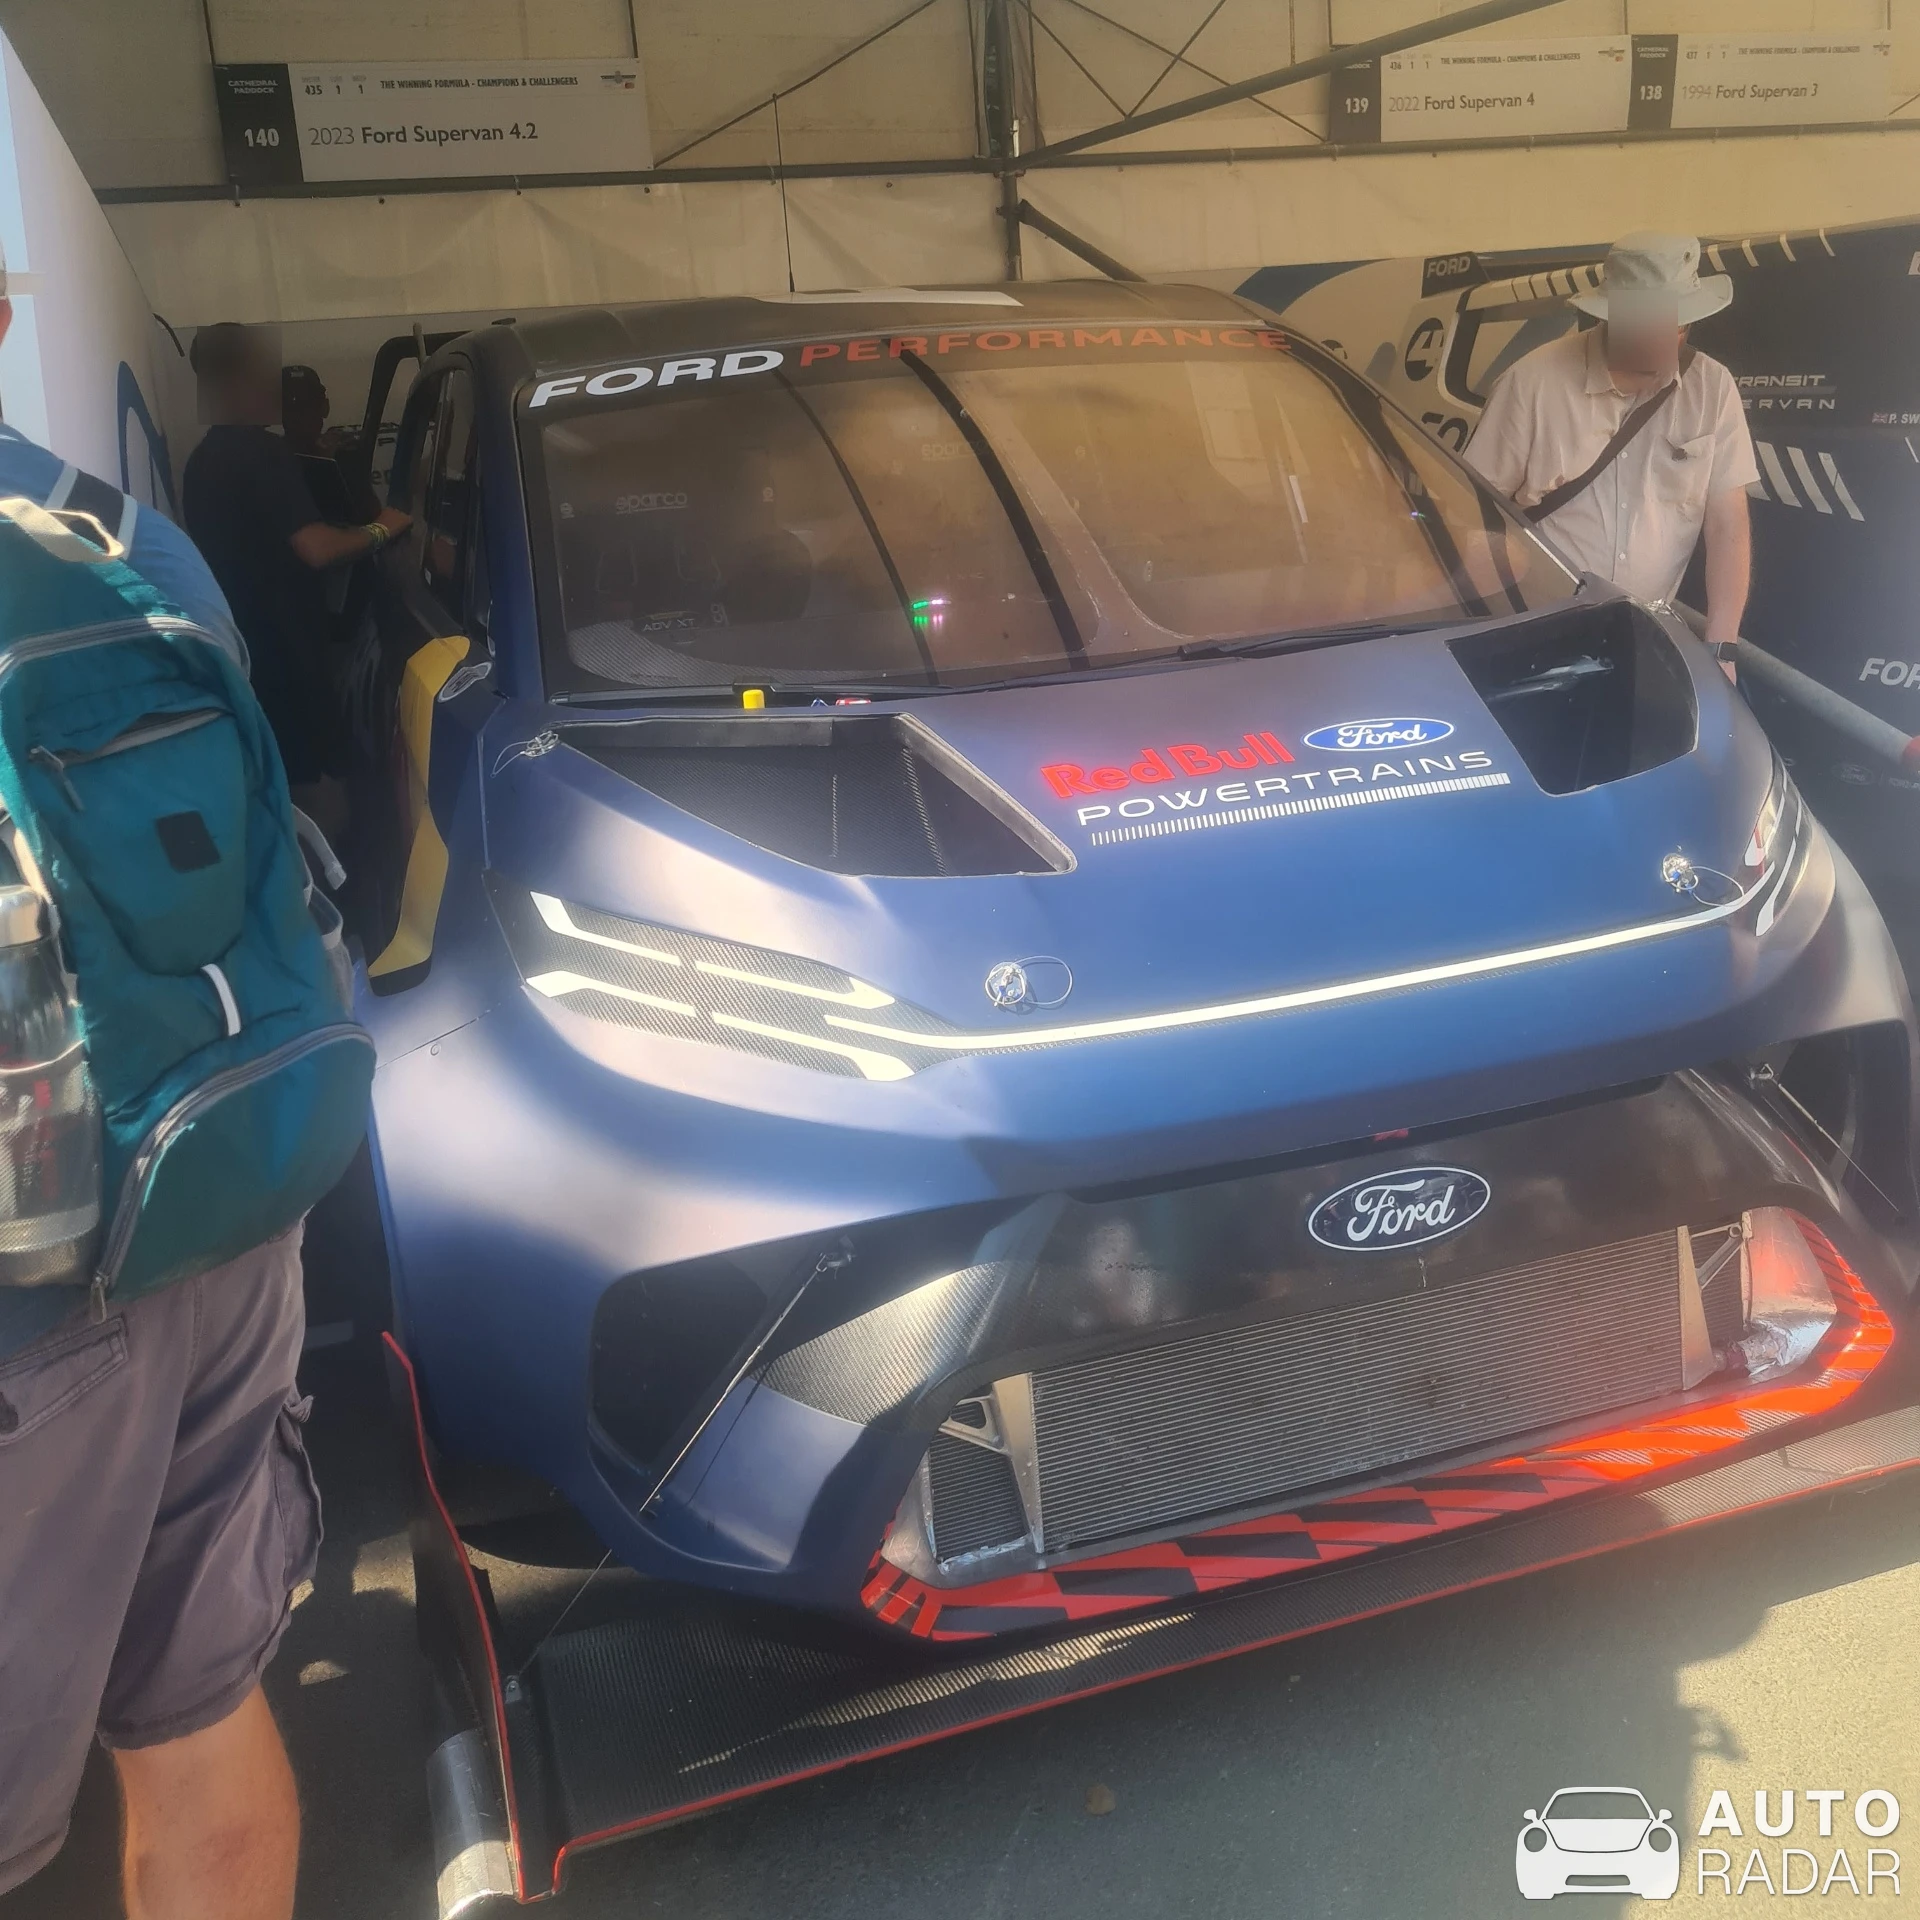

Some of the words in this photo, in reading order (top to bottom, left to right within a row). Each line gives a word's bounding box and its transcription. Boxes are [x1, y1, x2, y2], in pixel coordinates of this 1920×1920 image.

[1389, 61, 1402, 70] 436
[1441, 57, 1450, 65] THE
[1451, 56, 1476, 65] WINNING
[1476, 56, 1502, 64] FORMULA
[1507, 54, 1537, 63] CHAMPIONS
[1543, 53, 1581, 61] CHALLENGERS
[228, 79, 279, 88] CATHEDRAL
[234, 87, 275, 95] PADDOCK
[305, 84, 323, 95] 435
[335, 84, 342, 95] 1
[357, 84, 364, 94] 1
[380, 80, 396, 89] THE
[397, 79, 432, 89] WINNING
[434, 78, 470, 88] FORMULA
[476, 77, 519, 88] CHAMPIONS
[520, 77, 527, 87] &
[528, 76, 579, 87] CHALLENGERS
[1639, 85, 1663, 102] 138
[1681, 86, 1712, 99] 1994
[1715, 84, 1746, 99] Ford
[1750, 84, 1807, 102] Supervan
[1811, 83, 1819, 97] 3
[1345, 97, 1370, 114] 139
[1388, 97, 1421, 112] 2022
[1424, 95, 1455, 111] Ford
[1459, 93, 1522, 112] Supervan
[1526, 92, 1536, 106] 4
[244, 127, 280, 148] 140
[308, 127, 355, 146] 2023
[361, 126, 408, 145] Ford
[414, 124, 505, 147] Supervan
[508, 122, 539, 141] 4.2
[1426, 256, 1471, 278] FORD
[528, 348, 784, 409] FORD
[798, 326, 1295, 368] PERFORMANCE
[1742, 398, 1836, 410] ERVAN
[1901, 413, 1920, 424] SW
[676, 617, 696, 629] XT
[1336, 716, 1429, 750] Ford
[1041, 748, 1174, 799] Red
[1166, 731, 1297, 776] Bull
[1077, 750, 1495, 826] POWERTRAINS
[1346, 1178, 1456, 1242] Ford
